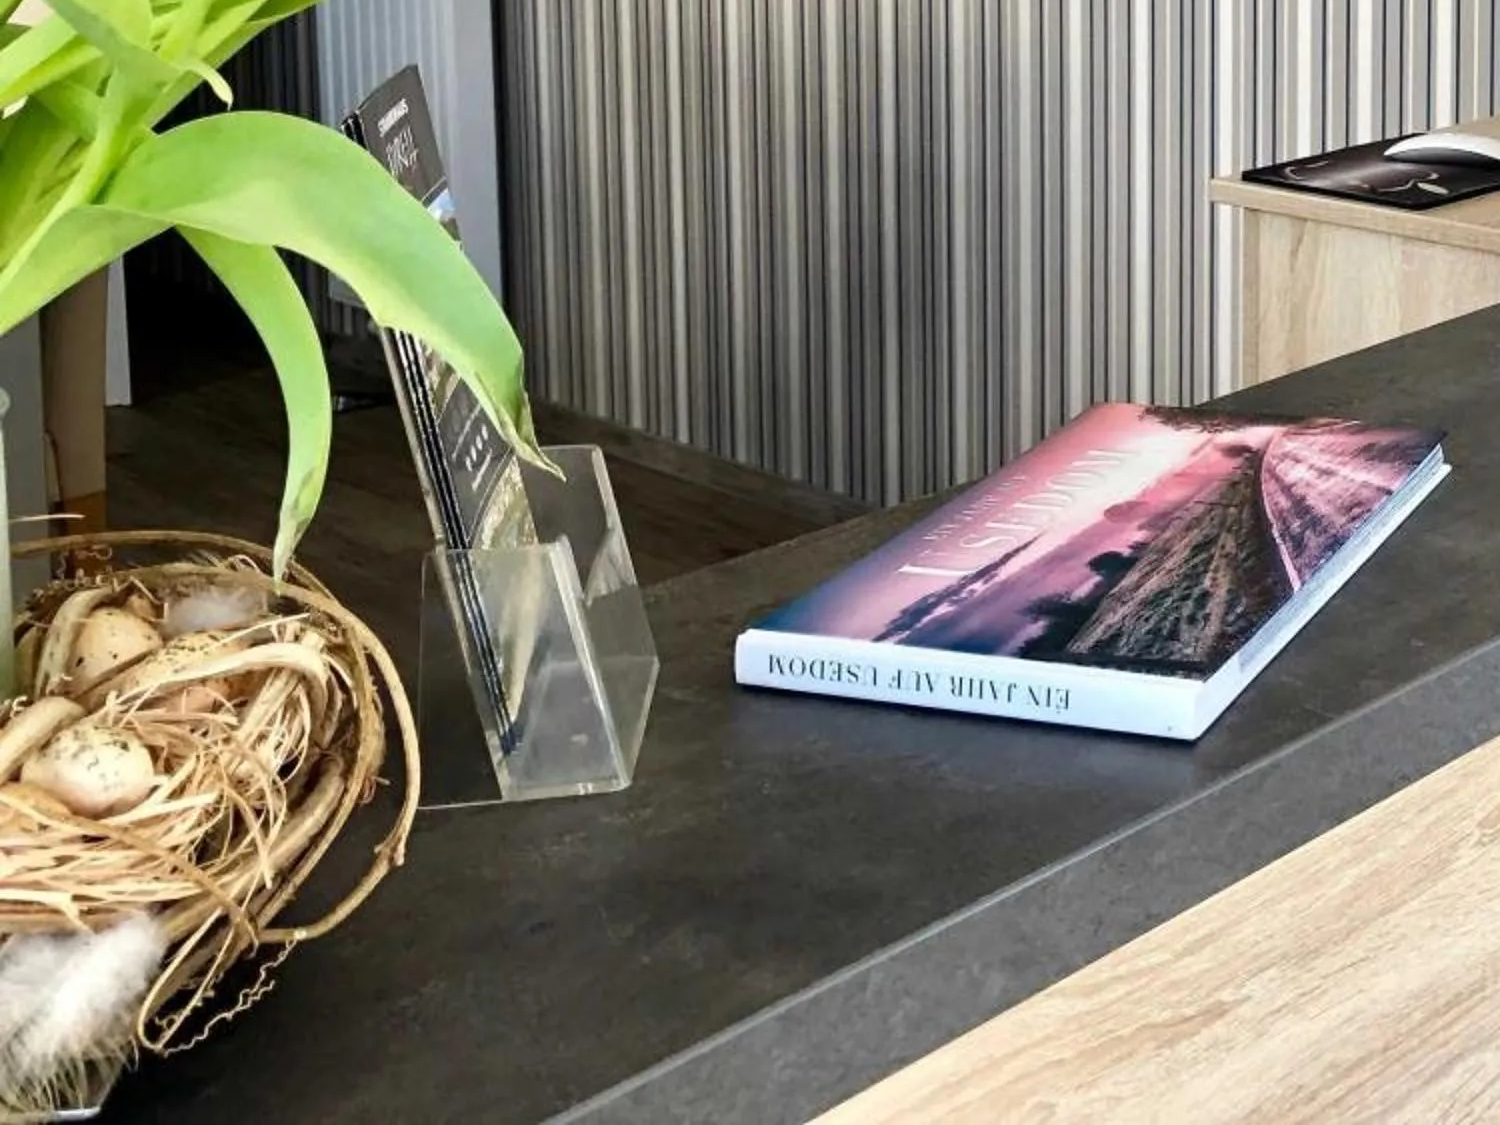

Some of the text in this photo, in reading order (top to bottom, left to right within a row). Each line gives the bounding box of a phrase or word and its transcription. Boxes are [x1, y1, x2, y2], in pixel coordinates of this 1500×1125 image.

[897, 450, 1140, 576] USEDOM
[767, 653, 1070, 710] EIN JAHR AUF USEDOM
